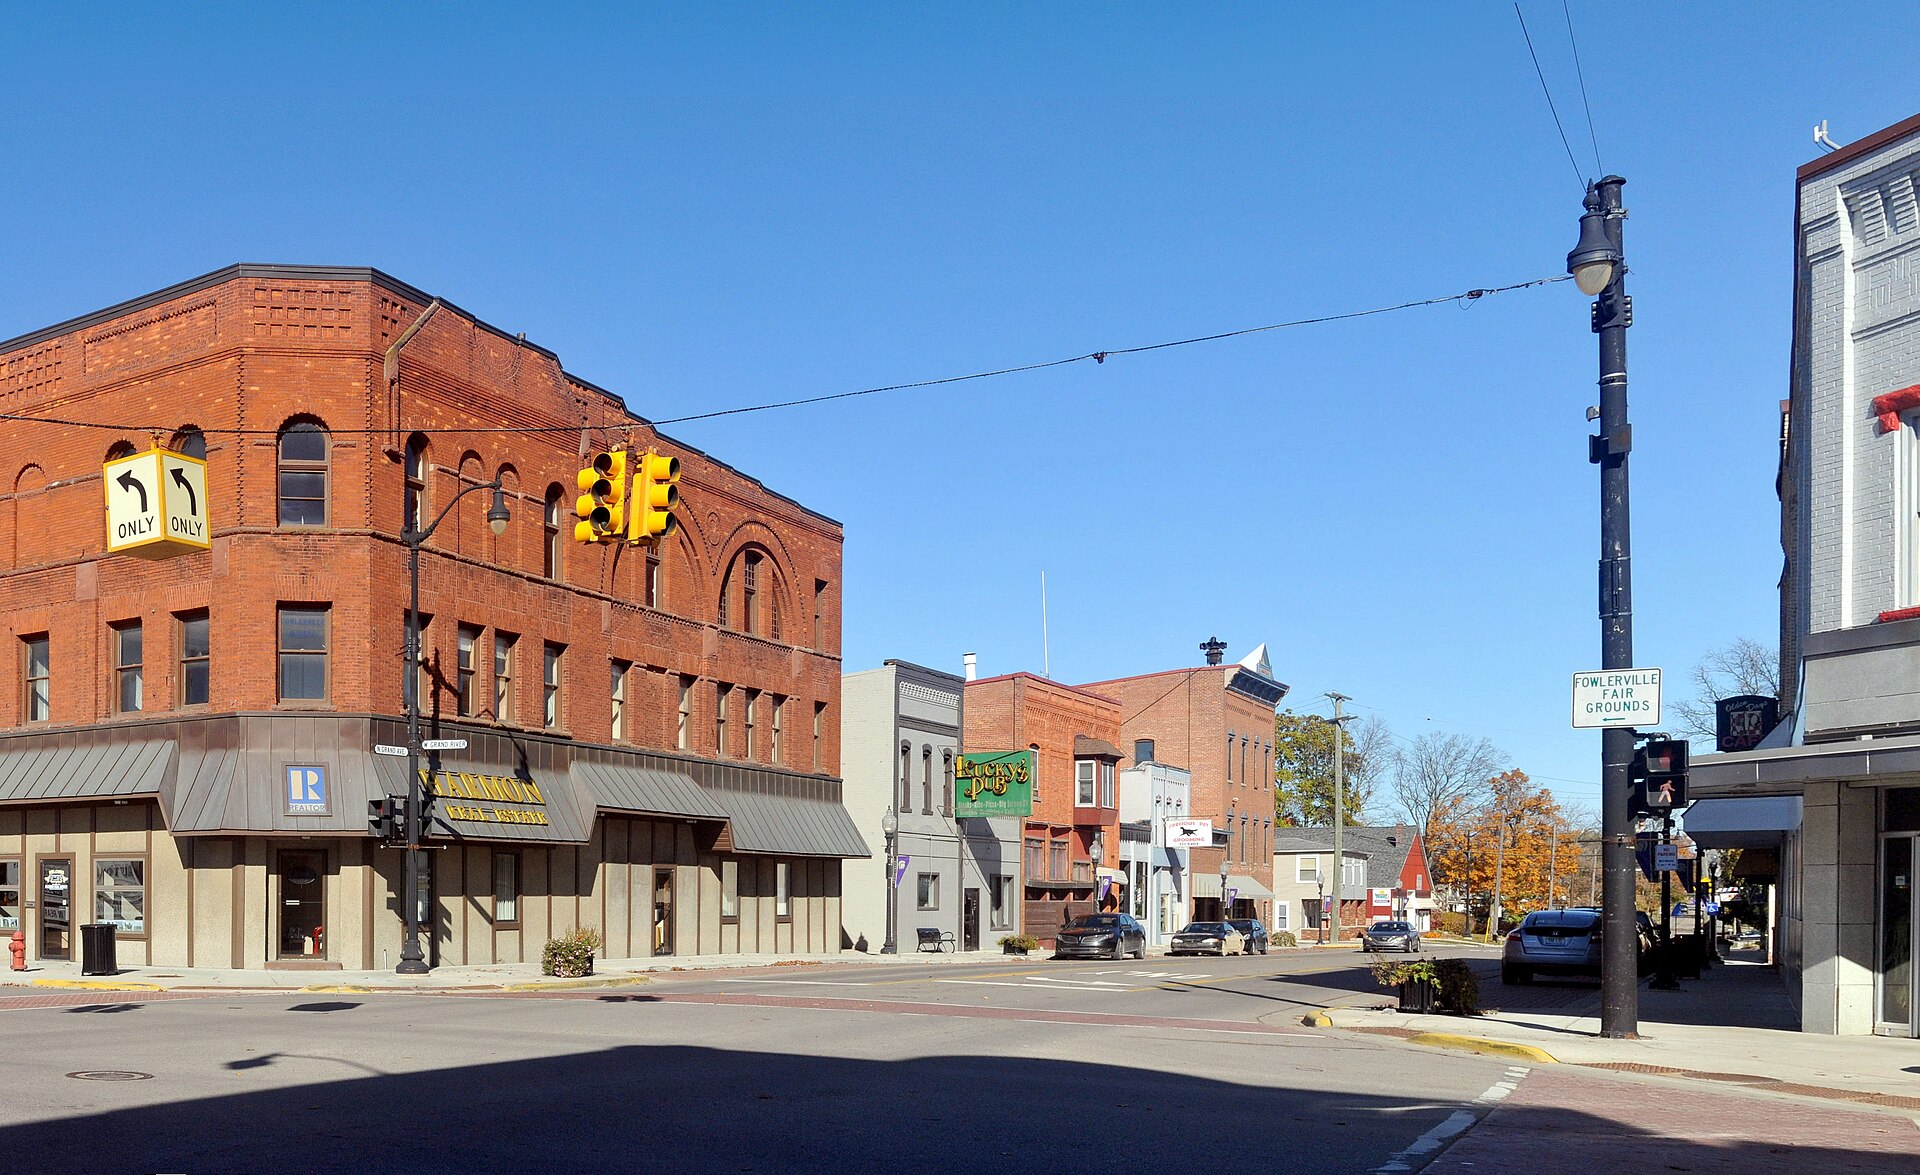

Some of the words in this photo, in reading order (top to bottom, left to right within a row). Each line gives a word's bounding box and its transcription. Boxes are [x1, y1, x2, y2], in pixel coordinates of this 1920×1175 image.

[119, 516, 154, 538] ONLY
[172, 516, 202, 537] ONLY
[1575, 673, 1658, 688] FOWLERVILLE
[1602, 688, 1633, 699] FAIR
[1586, 700, 1650, 713] GROUNDS
[381, 746, 396, 754] GRAND
[418, 768, 546, 804] HARMON
[289, 804, 326, 812] REALTOR
[445, 805, 488, 820] REAL
[493, 808, 548, 824] ESTATE
